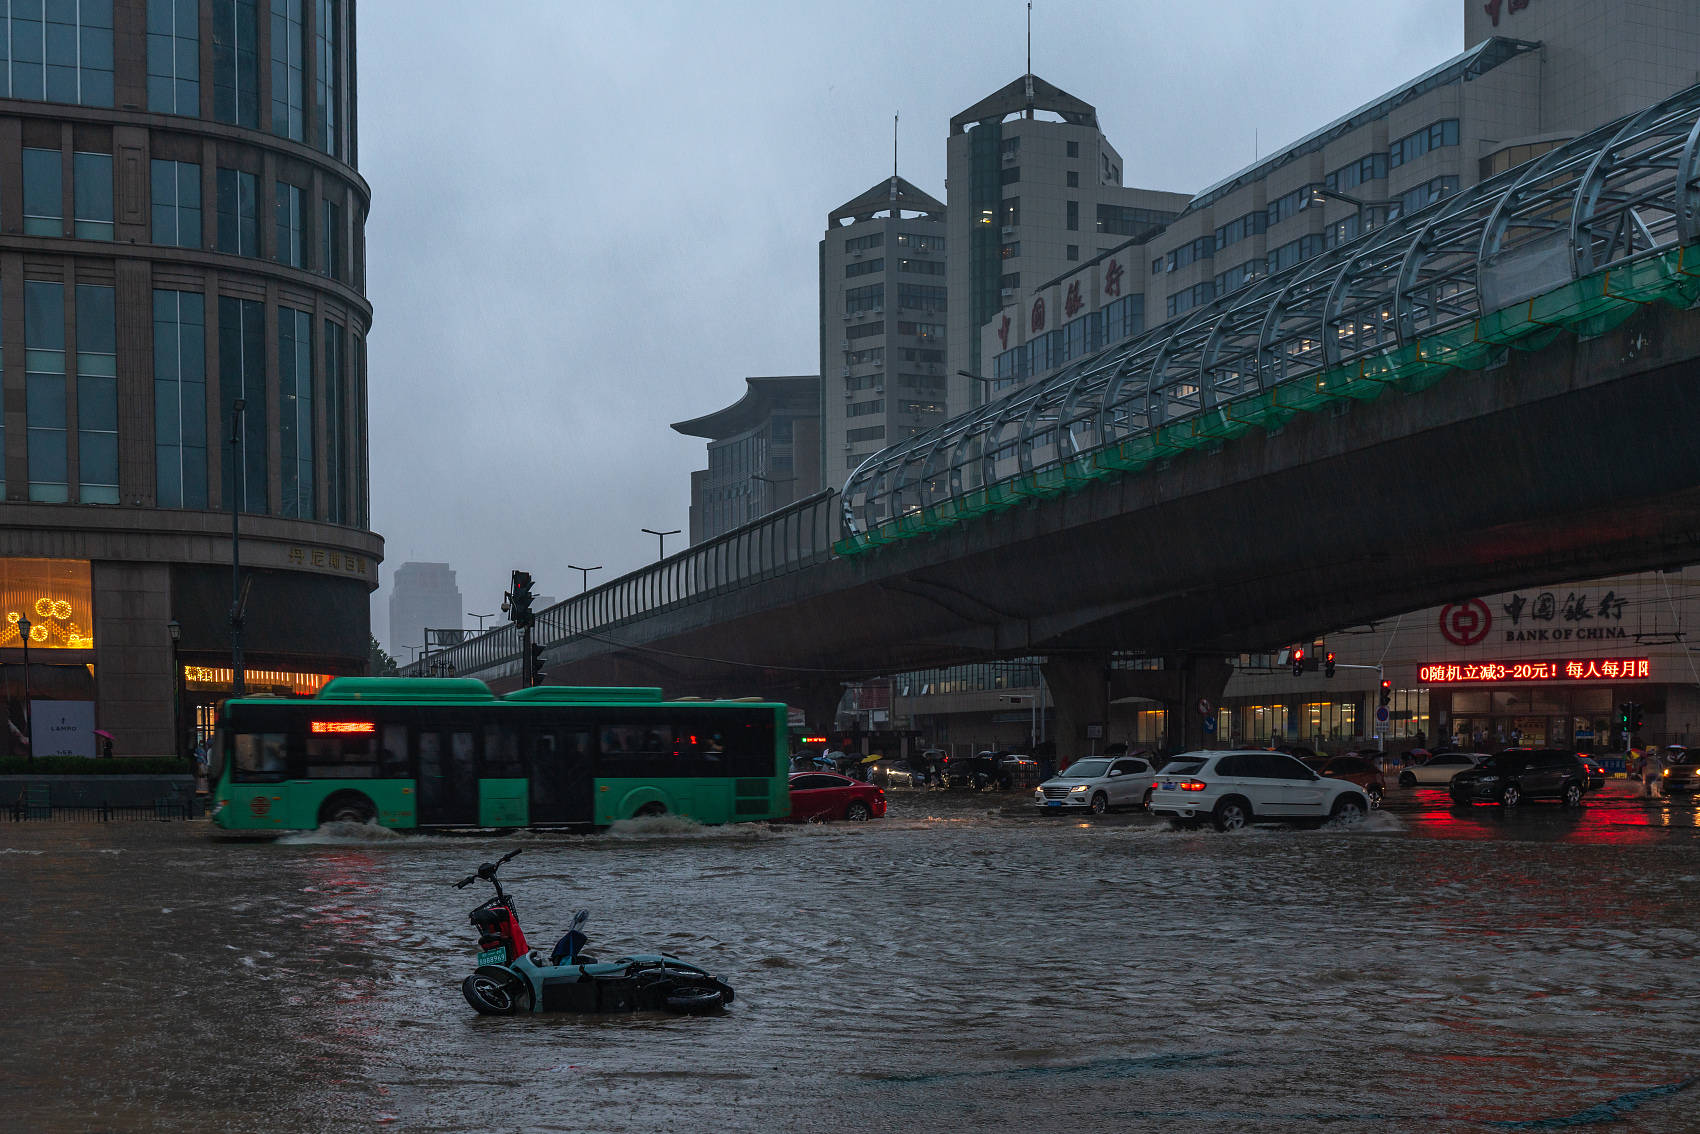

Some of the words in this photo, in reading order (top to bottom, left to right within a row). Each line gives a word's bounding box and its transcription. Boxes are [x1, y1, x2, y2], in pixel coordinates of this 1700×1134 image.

[1506, 630, 1549, 642] BANK
[1552, 629, 1573, 640] OF
[1576, 627, 1626, 639] CHINA
